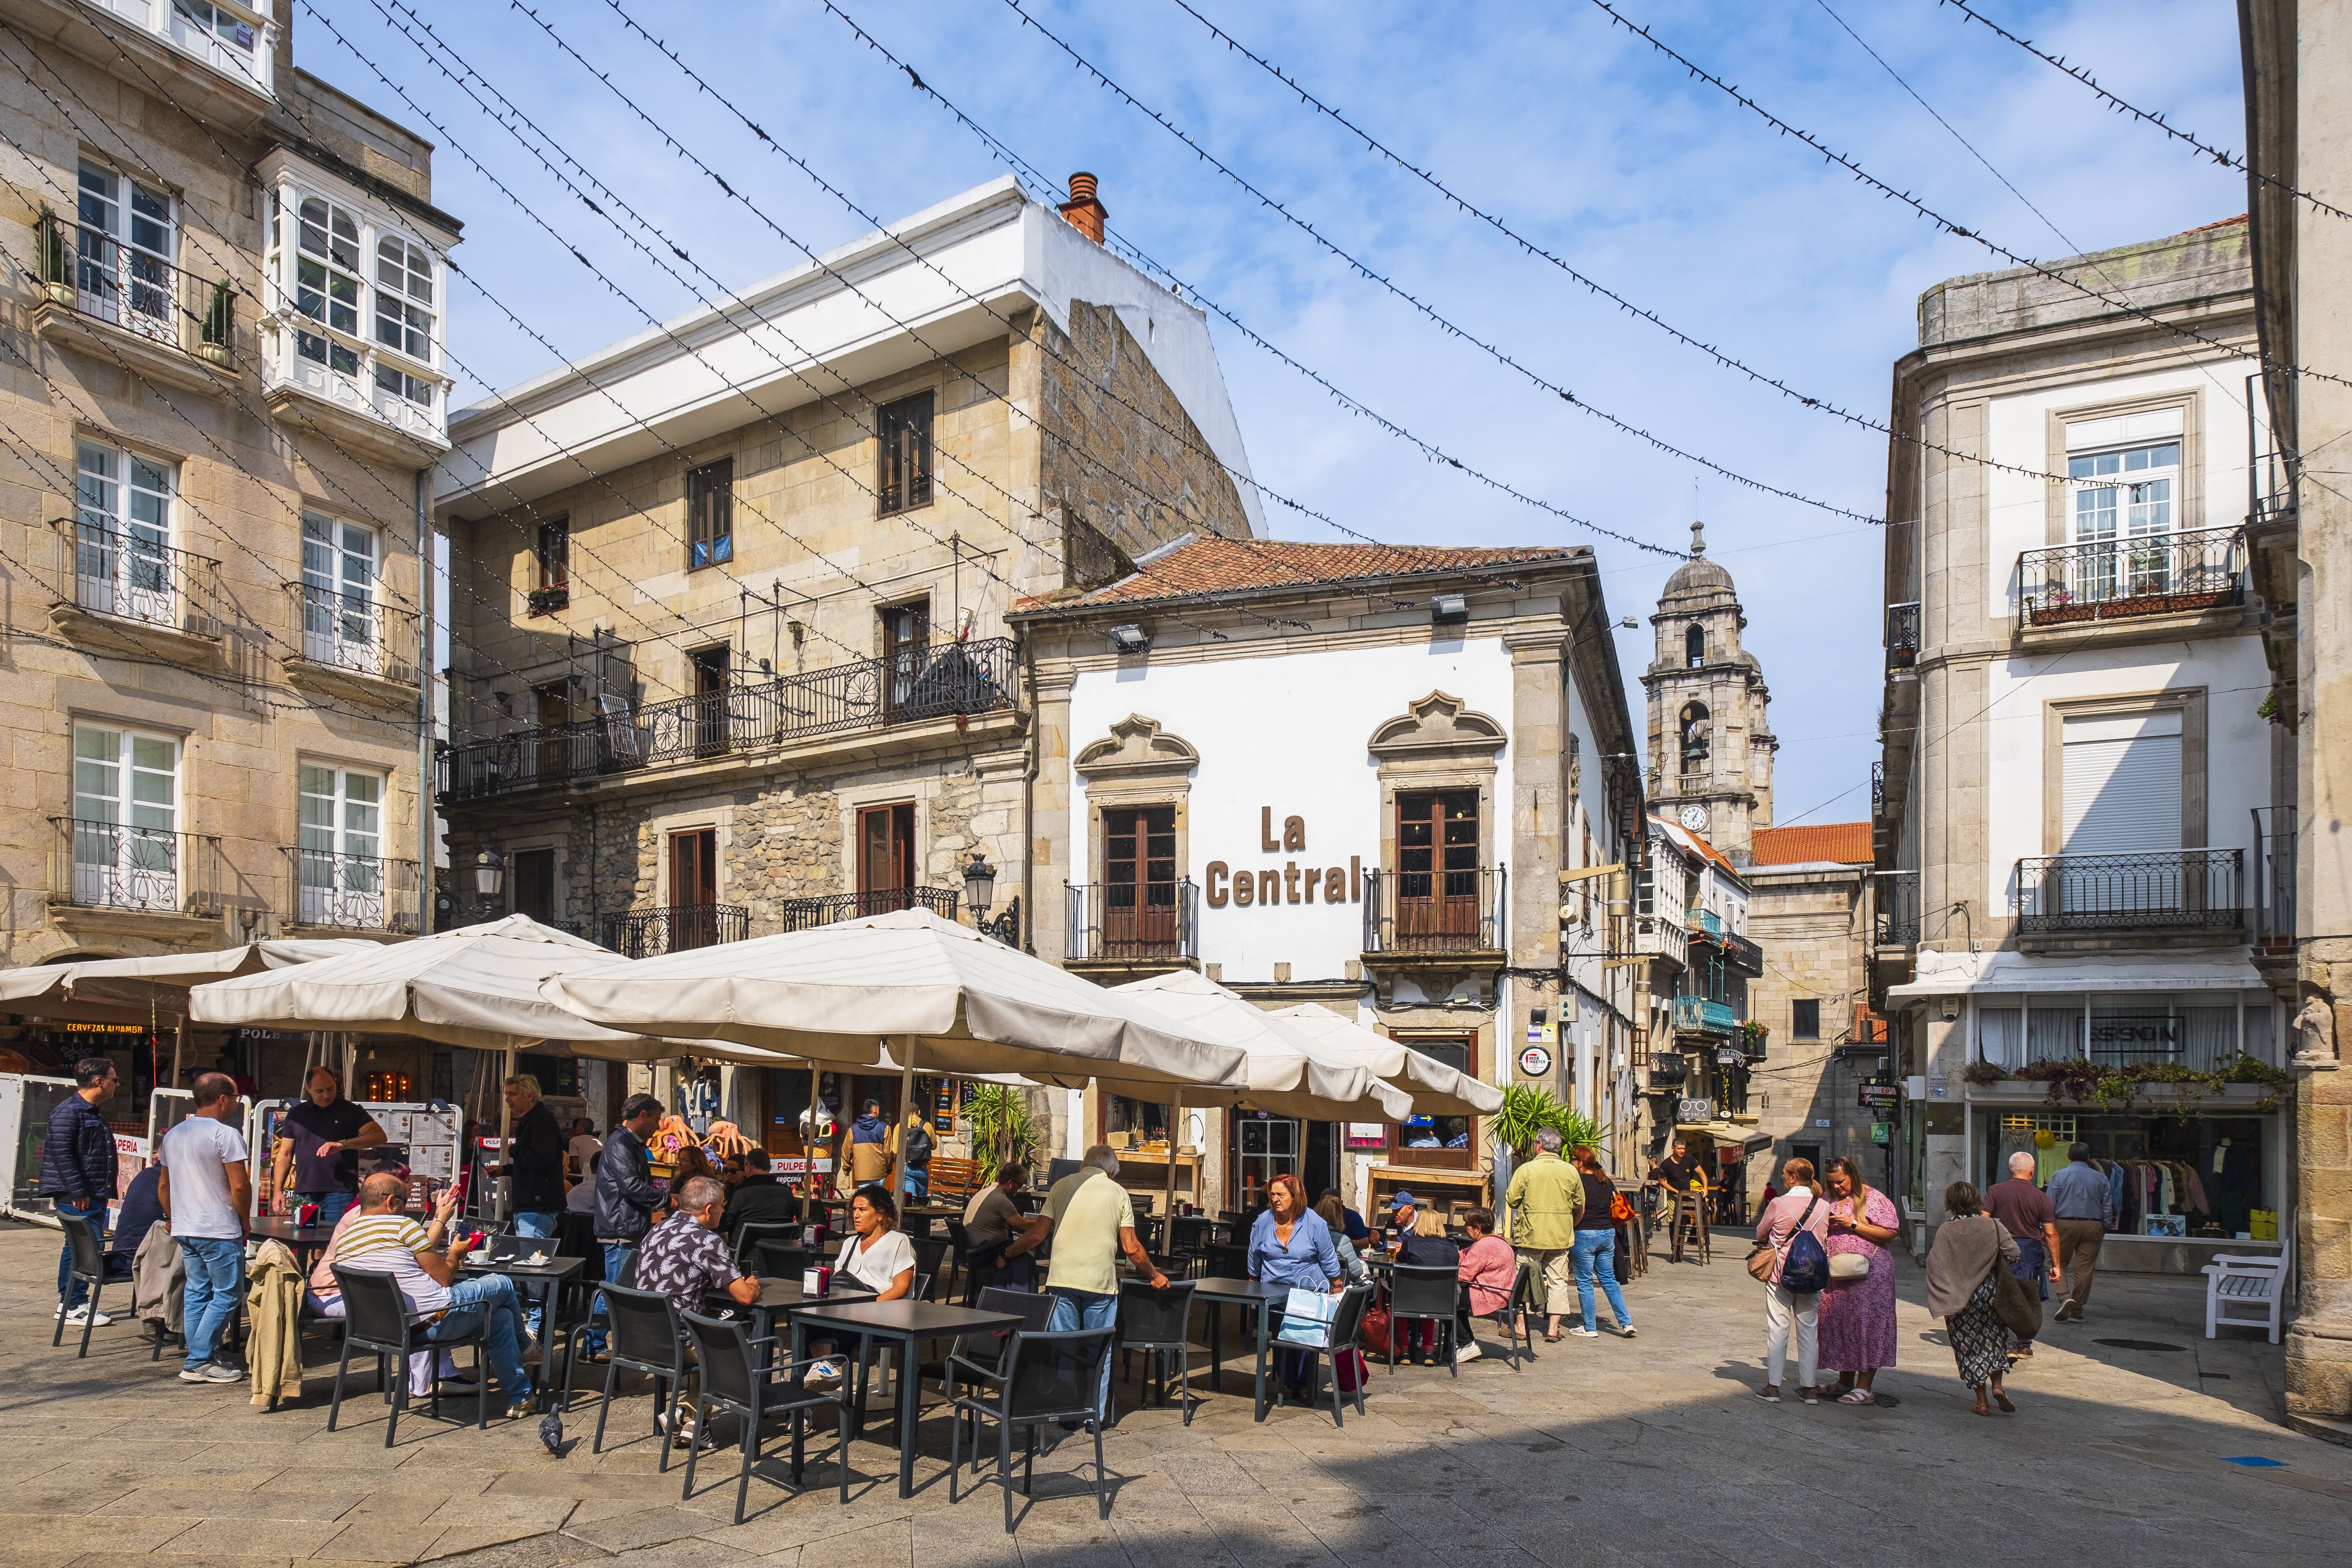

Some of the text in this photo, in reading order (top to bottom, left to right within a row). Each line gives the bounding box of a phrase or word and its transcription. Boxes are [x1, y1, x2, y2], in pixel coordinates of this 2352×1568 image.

[1262, 806, 1306, 851] La
[1206, 855, 1360, 906] Central
[67, 1023, 105, 1032] CERVEZAS
